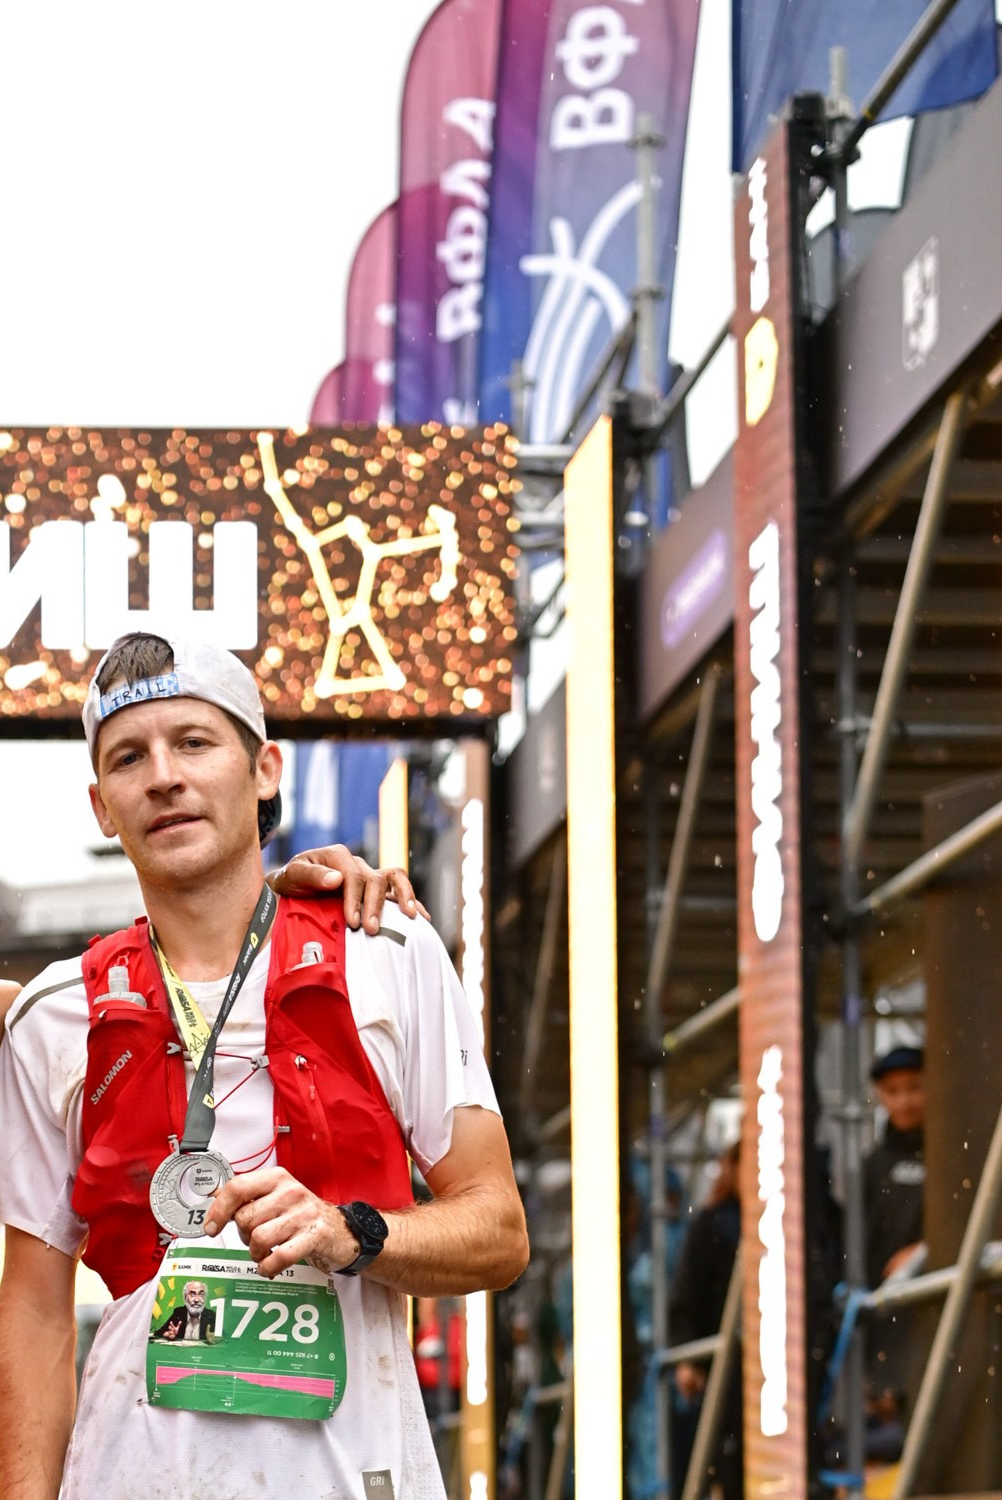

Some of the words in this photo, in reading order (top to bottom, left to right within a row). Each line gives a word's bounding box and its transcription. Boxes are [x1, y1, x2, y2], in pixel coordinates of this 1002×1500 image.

[550, 0, 647, 151] ВФ
[111, 683, 166, 707] TRAIL
[90, 1049, 133, 1105] SALOMON
[187, 1209, 206, 1225] 13
[286, 1269, 295, 1277] 13
[209, 1297, 320, 1344] 1728
[370, 1476, 385, 1486] GRi
